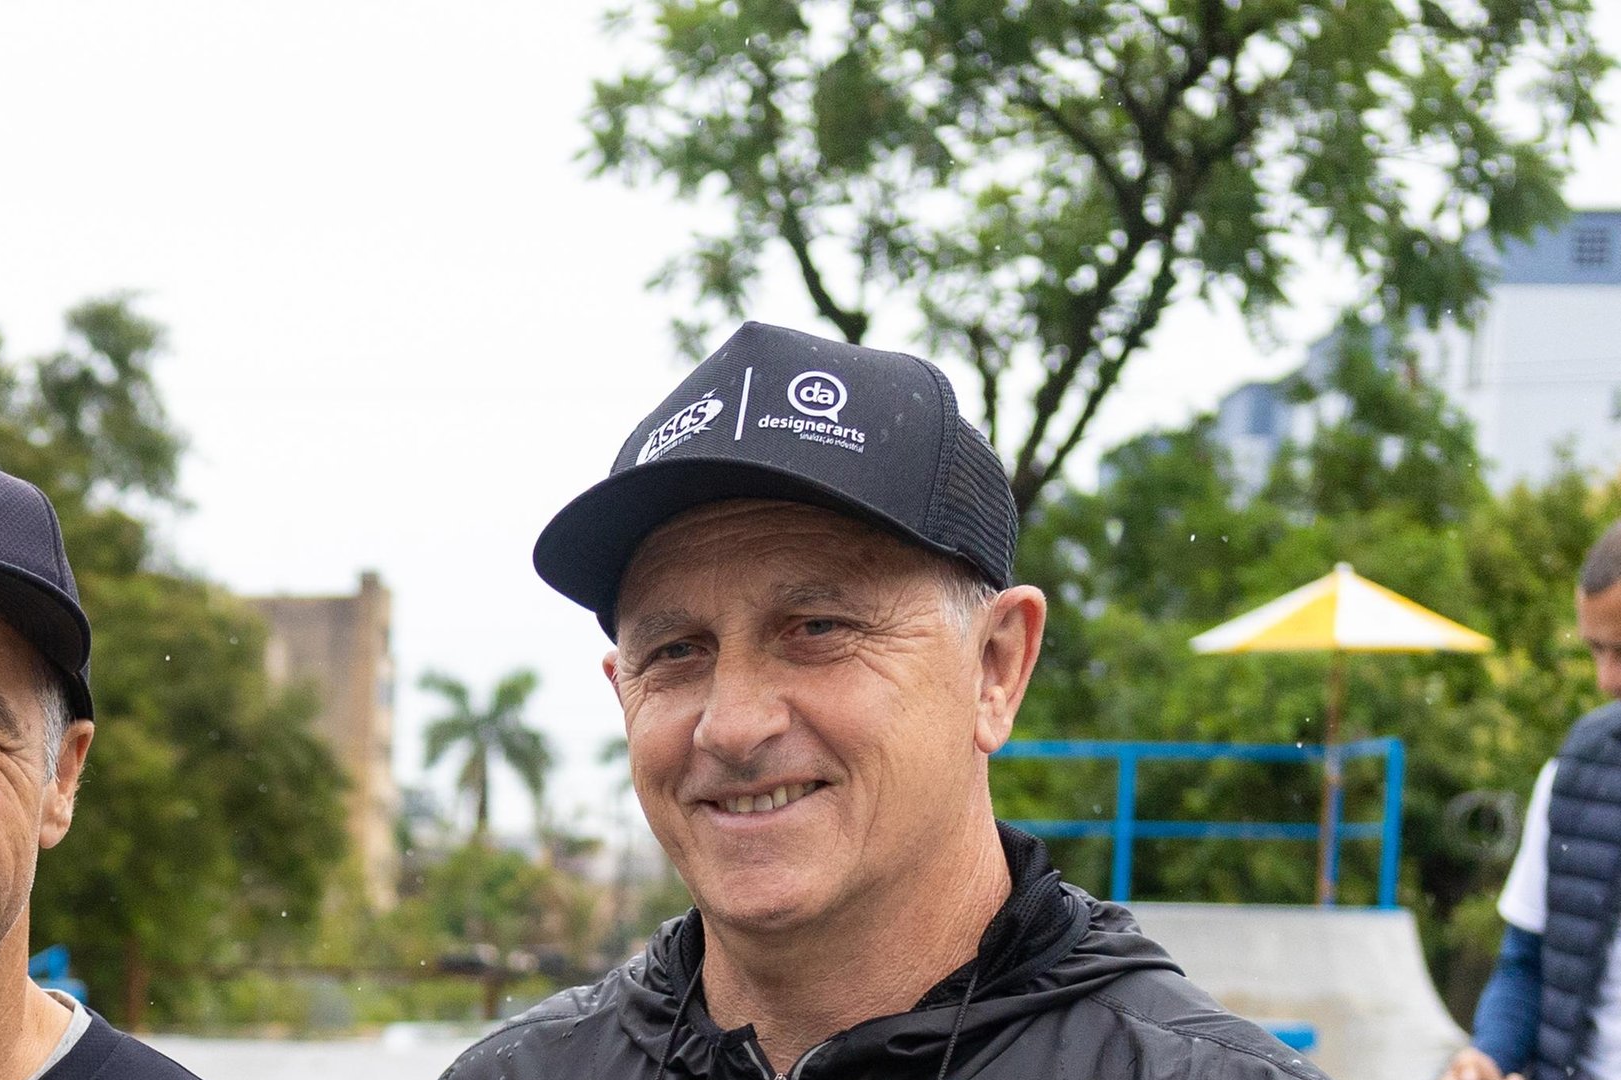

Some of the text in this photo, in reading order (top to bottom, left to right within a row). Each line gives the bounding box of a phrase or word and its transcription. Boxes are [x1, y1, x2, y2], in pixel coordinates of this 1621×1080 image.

[799, 382, 835, 405] da
[645, 401, 709, 457] ASCS
[758, 415, 866, 443] designerarts
[834, 438, 865, 454] industrial
